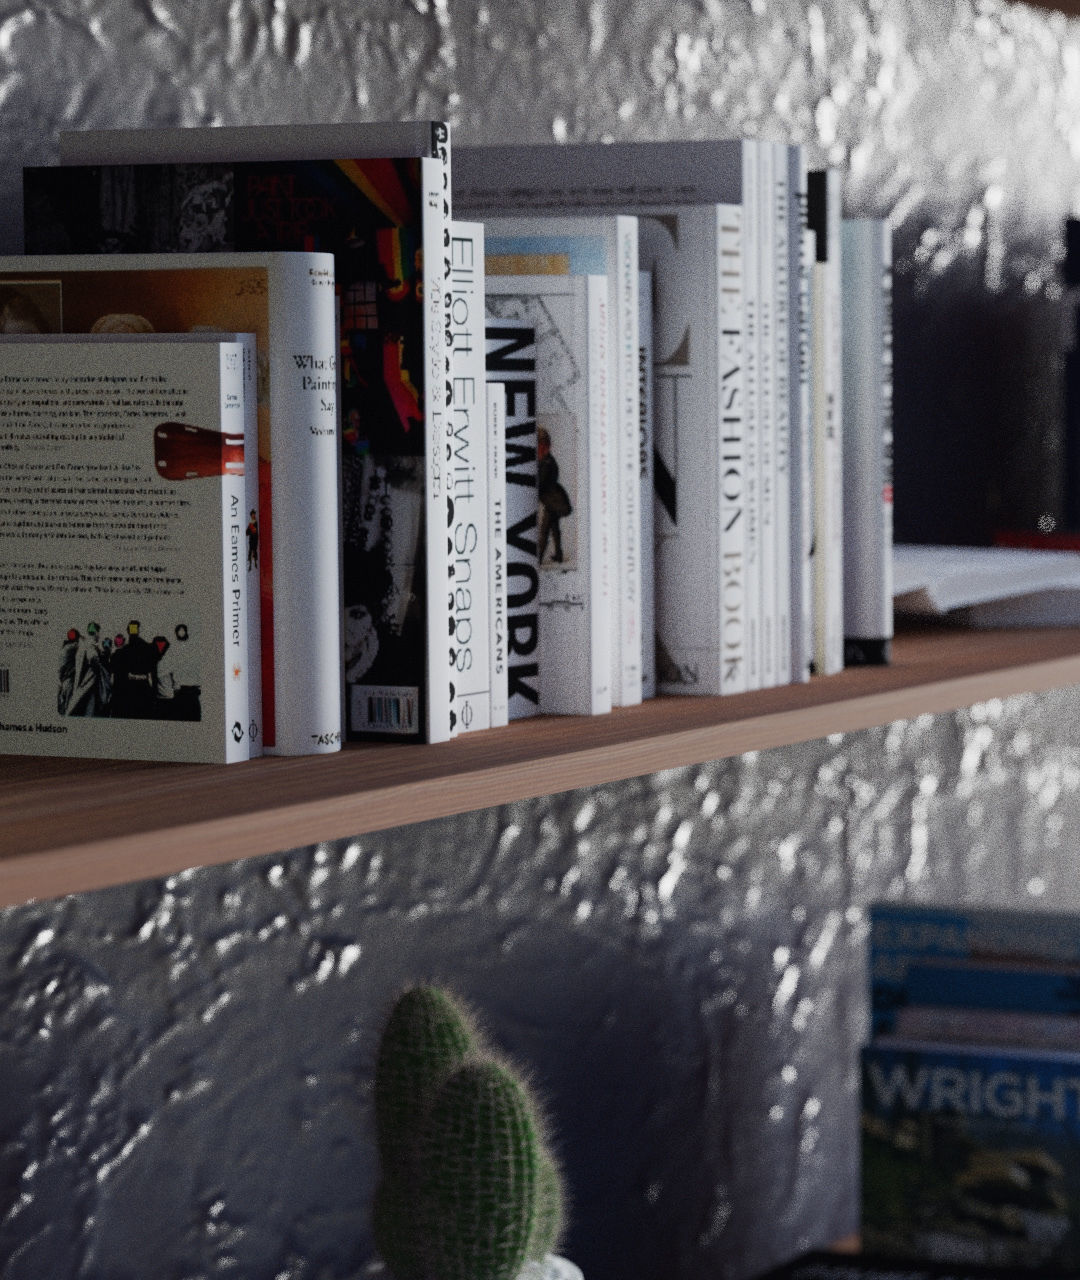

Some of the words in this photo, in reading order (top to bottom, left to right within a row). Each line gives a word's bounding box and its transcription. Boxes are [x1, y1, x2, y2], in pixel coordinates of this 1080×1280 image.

[452, 235, 474, 358] Elliott
[721, 213, 742, 315] THE
[452, 376, 476, 503] Erwitt
[485, 326, 537, 490] NEW
[721, 329, 743, 533] FASHION
[230, 494, 240, 518] An
[231, 523, 241, 583] Eames
[494, 498, 502, 539] THE
[232, 588, 242, 647] Primer
[454, 521, 478, 674] Snaps
[495, 547, 504, 676] AMERICANS
[506, 511, 539, 706] YORK
[722, 552, 743, 683] BOOK
[0, 722, 27, 732] hames
[35, 723, 68, 734] Hudson
